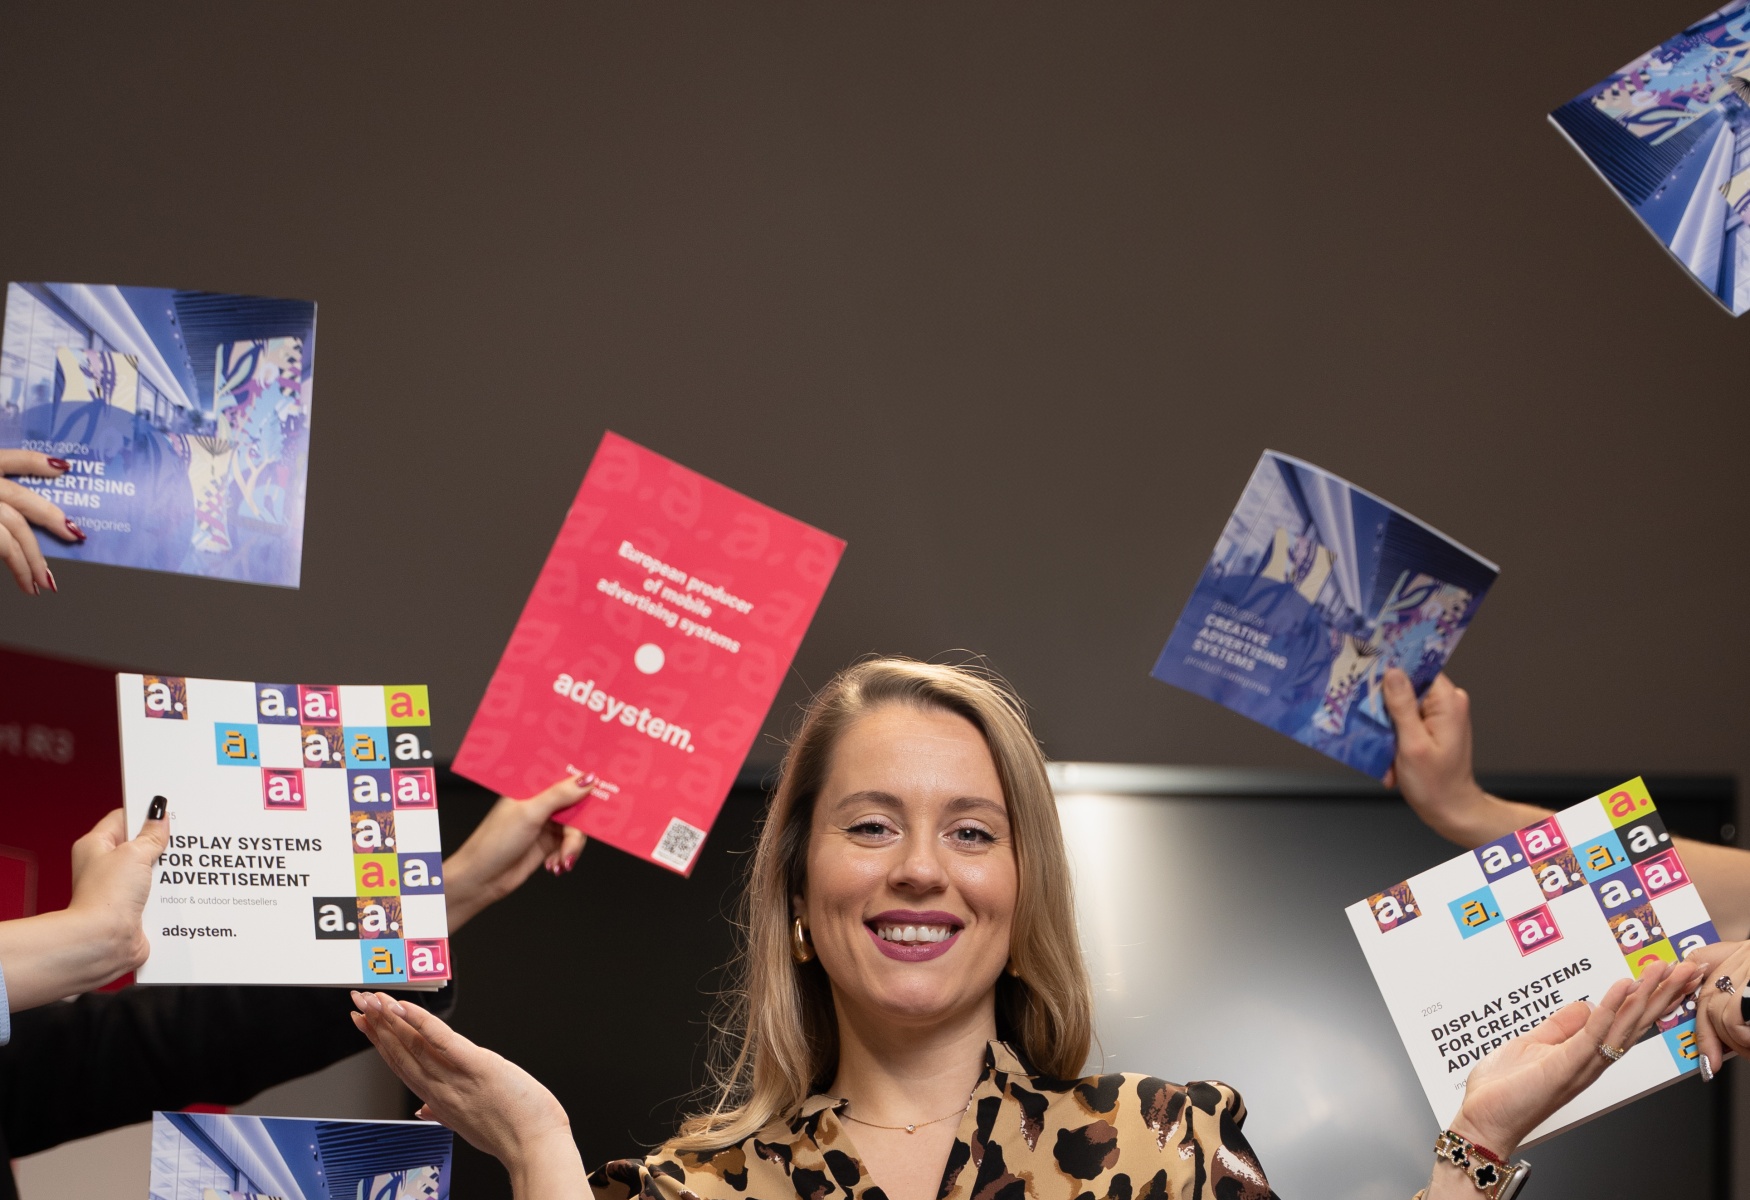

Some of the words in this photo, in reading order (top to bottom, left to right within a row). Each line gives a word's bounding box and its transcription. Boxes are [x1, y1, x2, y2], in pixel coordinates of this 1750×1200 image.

[617, 539, 688, 584] European
[686, 576, 754, 615] producer
[596, 577, 680, 628] advertising
[678, 617, 741, 653] systems
[643, 578, 664, 594] of
[660, 586, 712, 618] mobile
[552, 672, 695, 753] adsystem.
[158, 853, 194, 867] FOR
[198, 855, 286, 869] CREATIVE
[169, 835, 231, 850] ISPLAY
[238, 837, 322, 851] SYSTEMS
[159, 871, 310, 887] ADVERTISEMENT
[160, 896, 187, 904] indoor
[190, 896, 196, 904] &
[197, 896, 231, 905] outdoor
[232, 897, 278, 906] bestsellers
[162, 925, 237, 939] adsystem.
[1421, 1001, 1443, 1018] 2025
[1431, 997, 1503, 1041] DISPLAY
[1507, 958, 1592, 1005] SYSTEMS
[1438, 1032, 1475, 1057] FOR
[1477, 990, 1563, 1039] CREATIVE
[1448, 995, 1590, 1073] ADVERTISE
